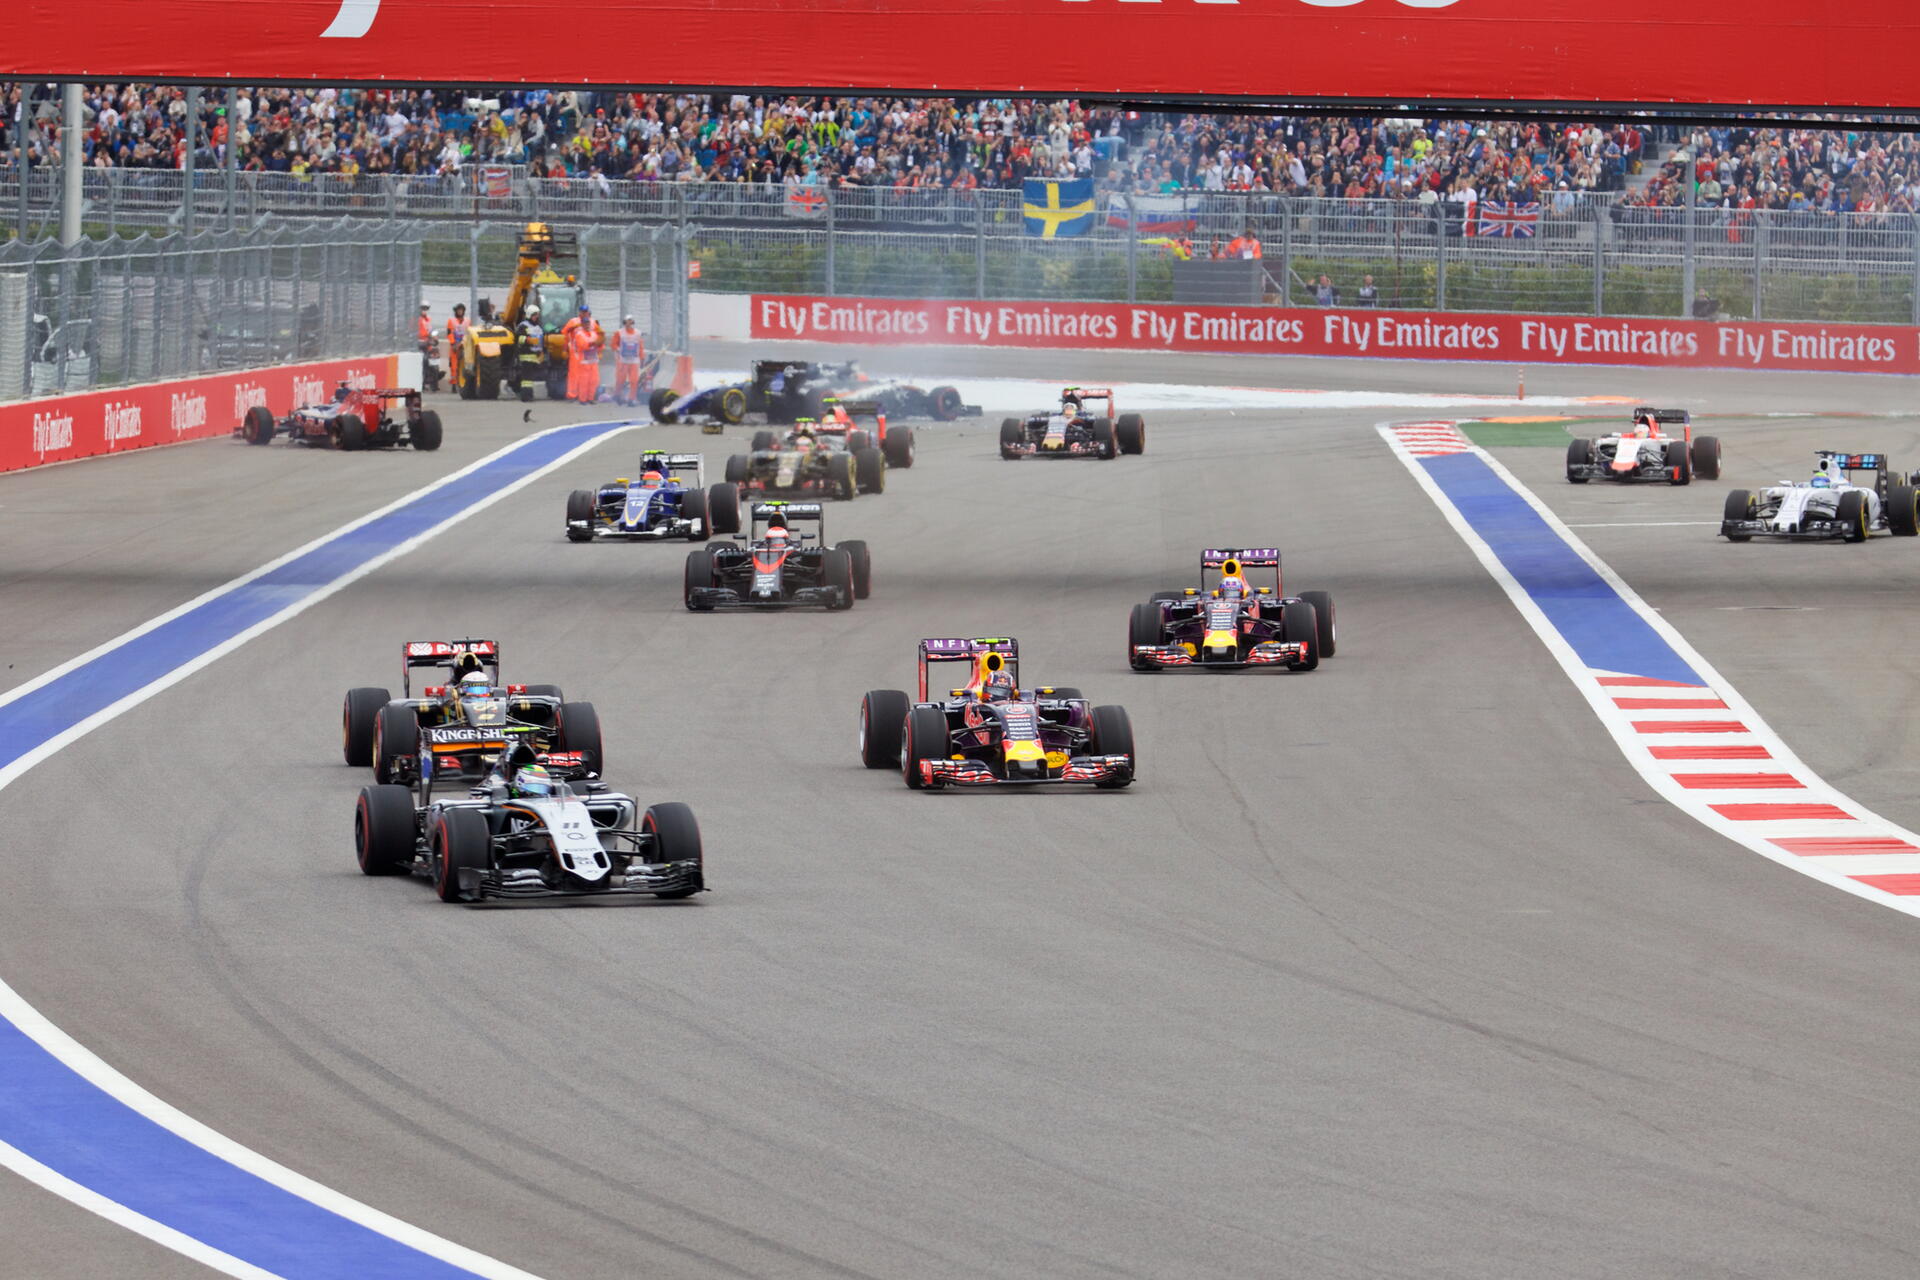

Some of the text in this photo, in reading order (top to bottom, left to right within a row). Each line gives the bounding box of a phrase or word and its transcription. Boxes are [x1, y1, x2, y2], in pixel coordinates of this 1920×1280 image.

[761, 300, 929, 335] Fly Emirates
[946, 306, 1117, 340] Fly Emirates
[1131, 309, 1304, 344] Fly Emirates
[1324, 315, 1500, 350] Fly Emirates
[1521, 321, 1698, 357] Fly Emirates
[1718, 327, 1896, 363] Fly Emirates
[45, 409, 73, 450] Emirates
[115, 400, 141, 439] Emirates
